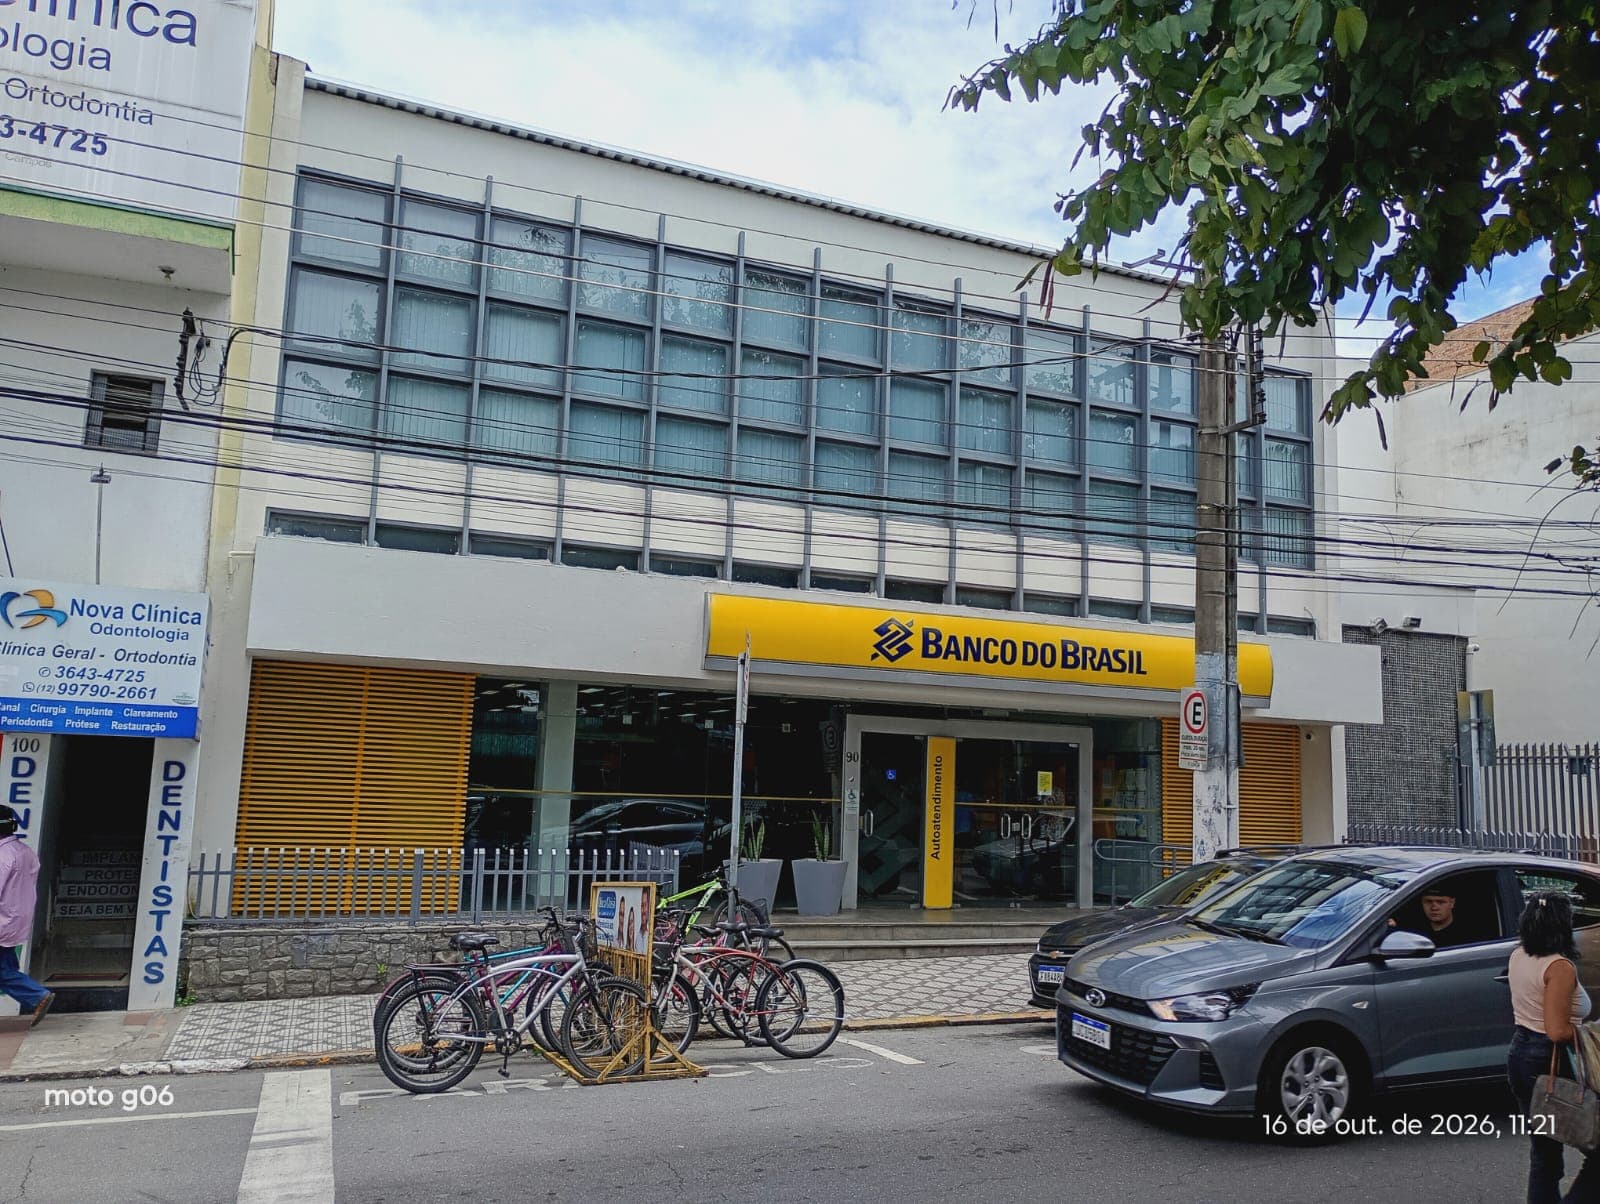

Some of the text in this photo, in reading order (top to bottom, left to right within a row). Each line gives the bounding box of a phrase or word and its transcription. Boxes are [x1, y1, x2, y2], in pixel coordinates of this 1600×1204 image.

[5, 78, 153, 125] Ortodontia
[70, 599, 201, 625] Nova Clínica
[90, 623, 189, 642] Odontologia
[0, 642, 45, 657] línica
[52, 645, 96, 660] Geral
[114, 648, 197, 666] Ortodontia
[921, 627, 1147, 675] BANCO DO BRASIL
[55, 666, 146, 682] 3643-4725
[57, 682, 157, 700] 99790-2661
[30, 703, 66, 714] Cirurgia
[75, 706, 113, 717] Implante
[123, 708, 178, 719] Clareamento
[1192, 702, 1202, 725] E
[1, 716, 166, 732] Periodontia Prótese Restauração
[11, 738, 40, 753] 100
[846, 752, 859, 763] 90
[931, 755, 942, 860] Autoatendimento
[143, 761, 186, 984] DENTISTAS
[60, 905, 93, 915] SEJA
[96, 903, 123, 914] BEM
